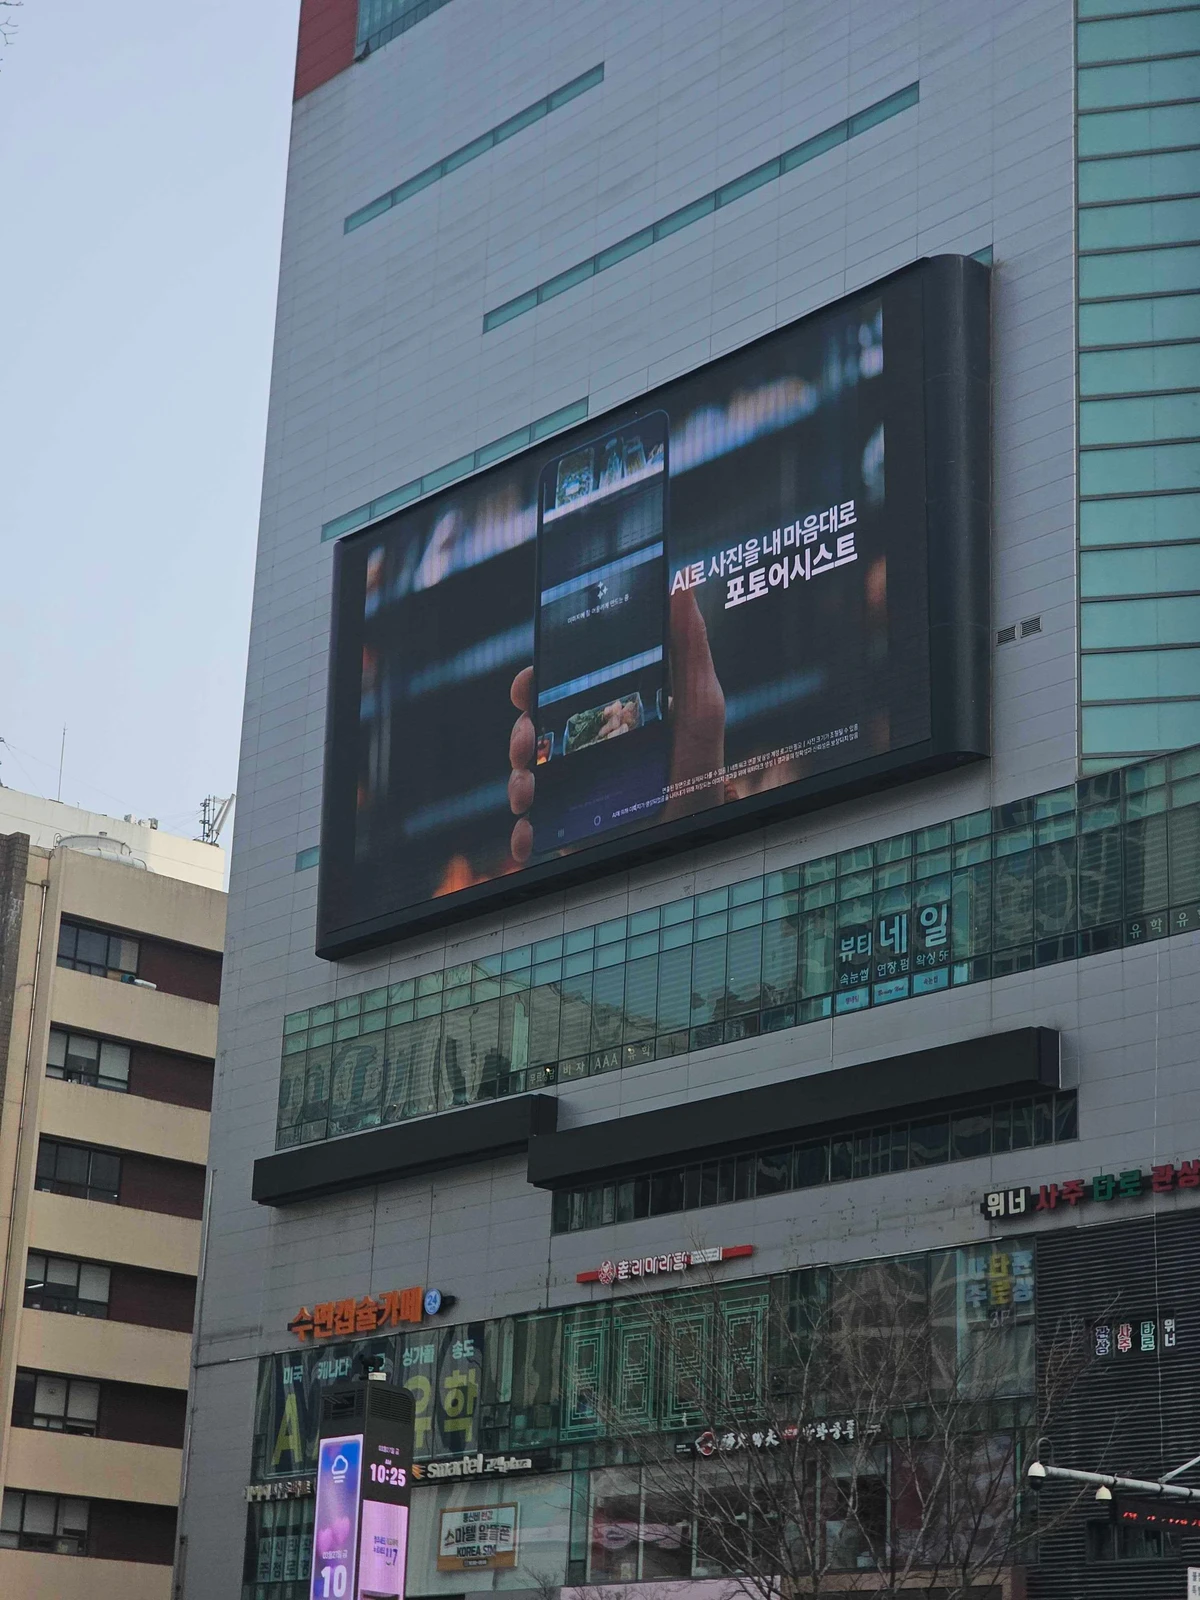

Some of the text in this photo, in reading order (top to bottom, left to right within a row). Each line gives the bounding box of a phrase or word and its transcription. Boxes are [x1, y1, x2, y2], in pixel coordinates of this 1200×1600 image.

[670, 499, 858, 596] AI로 사진을 내 마음대로
[724, 532, 858, 610] 포토어시스트
[704, 771, 713, 780] 다를
[839, 903, 949, 963] 뷰티 네일
[1129, 917, 1163, 939] 유학
[840, 967, 870, 986] 속눈썹
[916, 951, 937, 967] 왁싱
[938, 949, 949, 962] 5F
[563, 1061, 585, 1076] 비자
[594, 1053, 618, 1070] AAA
[627, 1045, 650, 1061] 유학
[987, 1158, 1200, 1218] 위너 사주 타로 관상
[617, 1251, 689, 1281] 춘리마라탕
[989, 1252, 1012, 1305] 타로
[1011, 1250, 1034, 1303] 관상
[290, 1286, 438, 1343] 수면캡슐카페 24
[989, 1309, 1011, 1329] 3F
[1117, 1323, 1132, 1353] 사주
[1140, 1320, 1156, 1351] 타로
[1164, 1318, 1176, 1347] 위너
[282, 1364, 304, 1385] 미국
[317, 1357, 351, 1380] 캐나다
[402, 1343, 436, 1368] 싱가폴
[452, 1339, 475, 1360] 송도
[370, 1463, 407, 1488] 10:25
[427, 1453, 484, 1479] smartel
[444, 1522, 511, 1546] 스마텔 알뜰폰
[456, 1544, 497, 1558] KOREA SIM
[320, 1564, 347, 1599] 10
